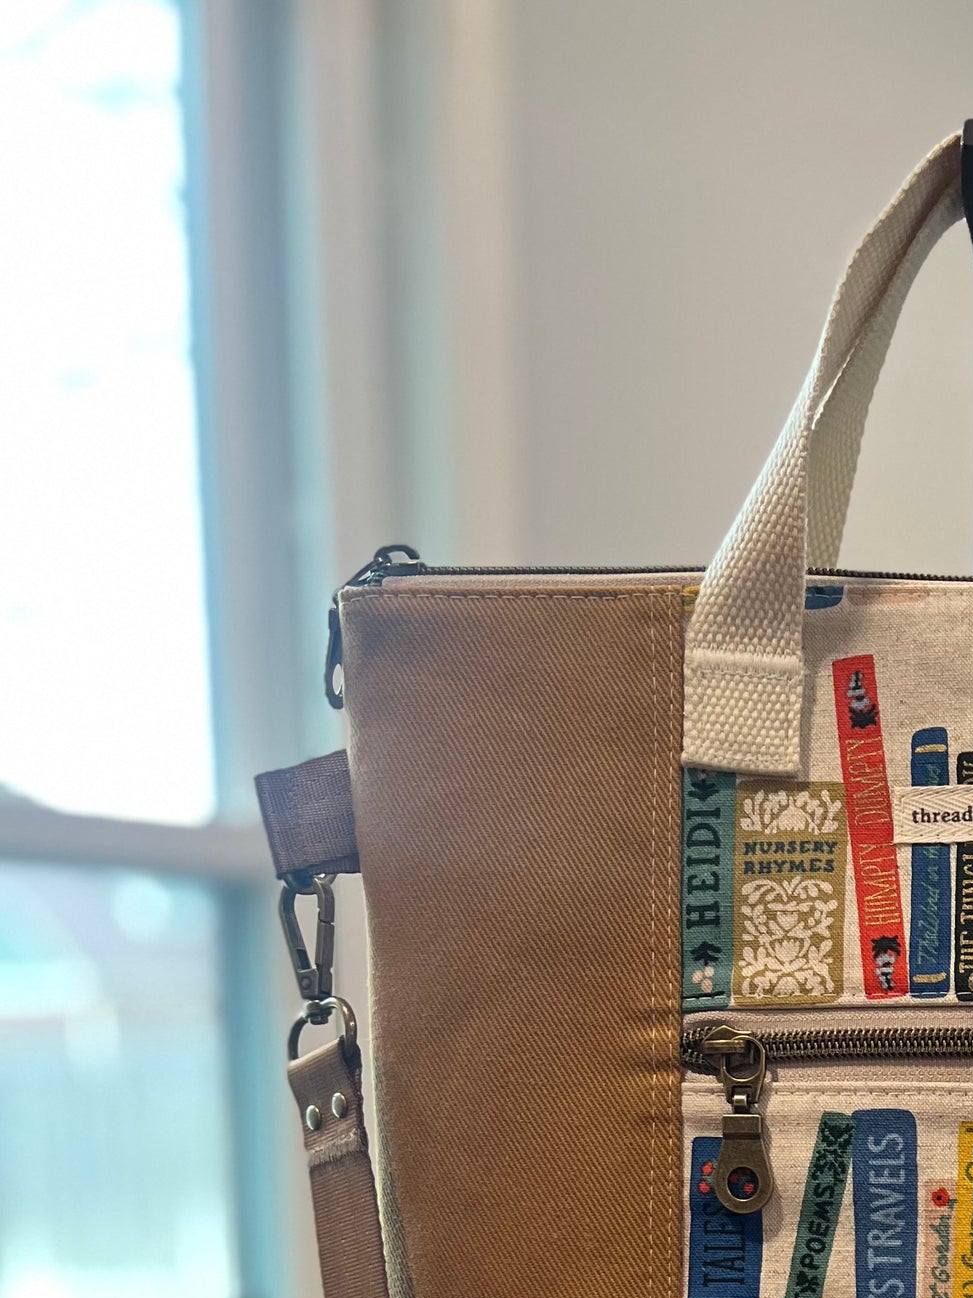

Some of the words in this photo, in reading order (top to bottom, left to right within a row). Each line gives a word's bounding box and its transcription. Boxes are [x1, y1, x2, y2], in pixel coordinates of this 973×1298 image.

[845, 736, 890, 826] DUMPTY
[685, 807, 721, 930] HEIDI
[743, 840, 838, 856] NURSERY
[743, 858, 835, 875] RHYMES
[859, 841, 901, 927] HUMPTY
[800, 1181, 835, 1271] POEMS
[867, 1133, 906, 1271] TRAVELS
